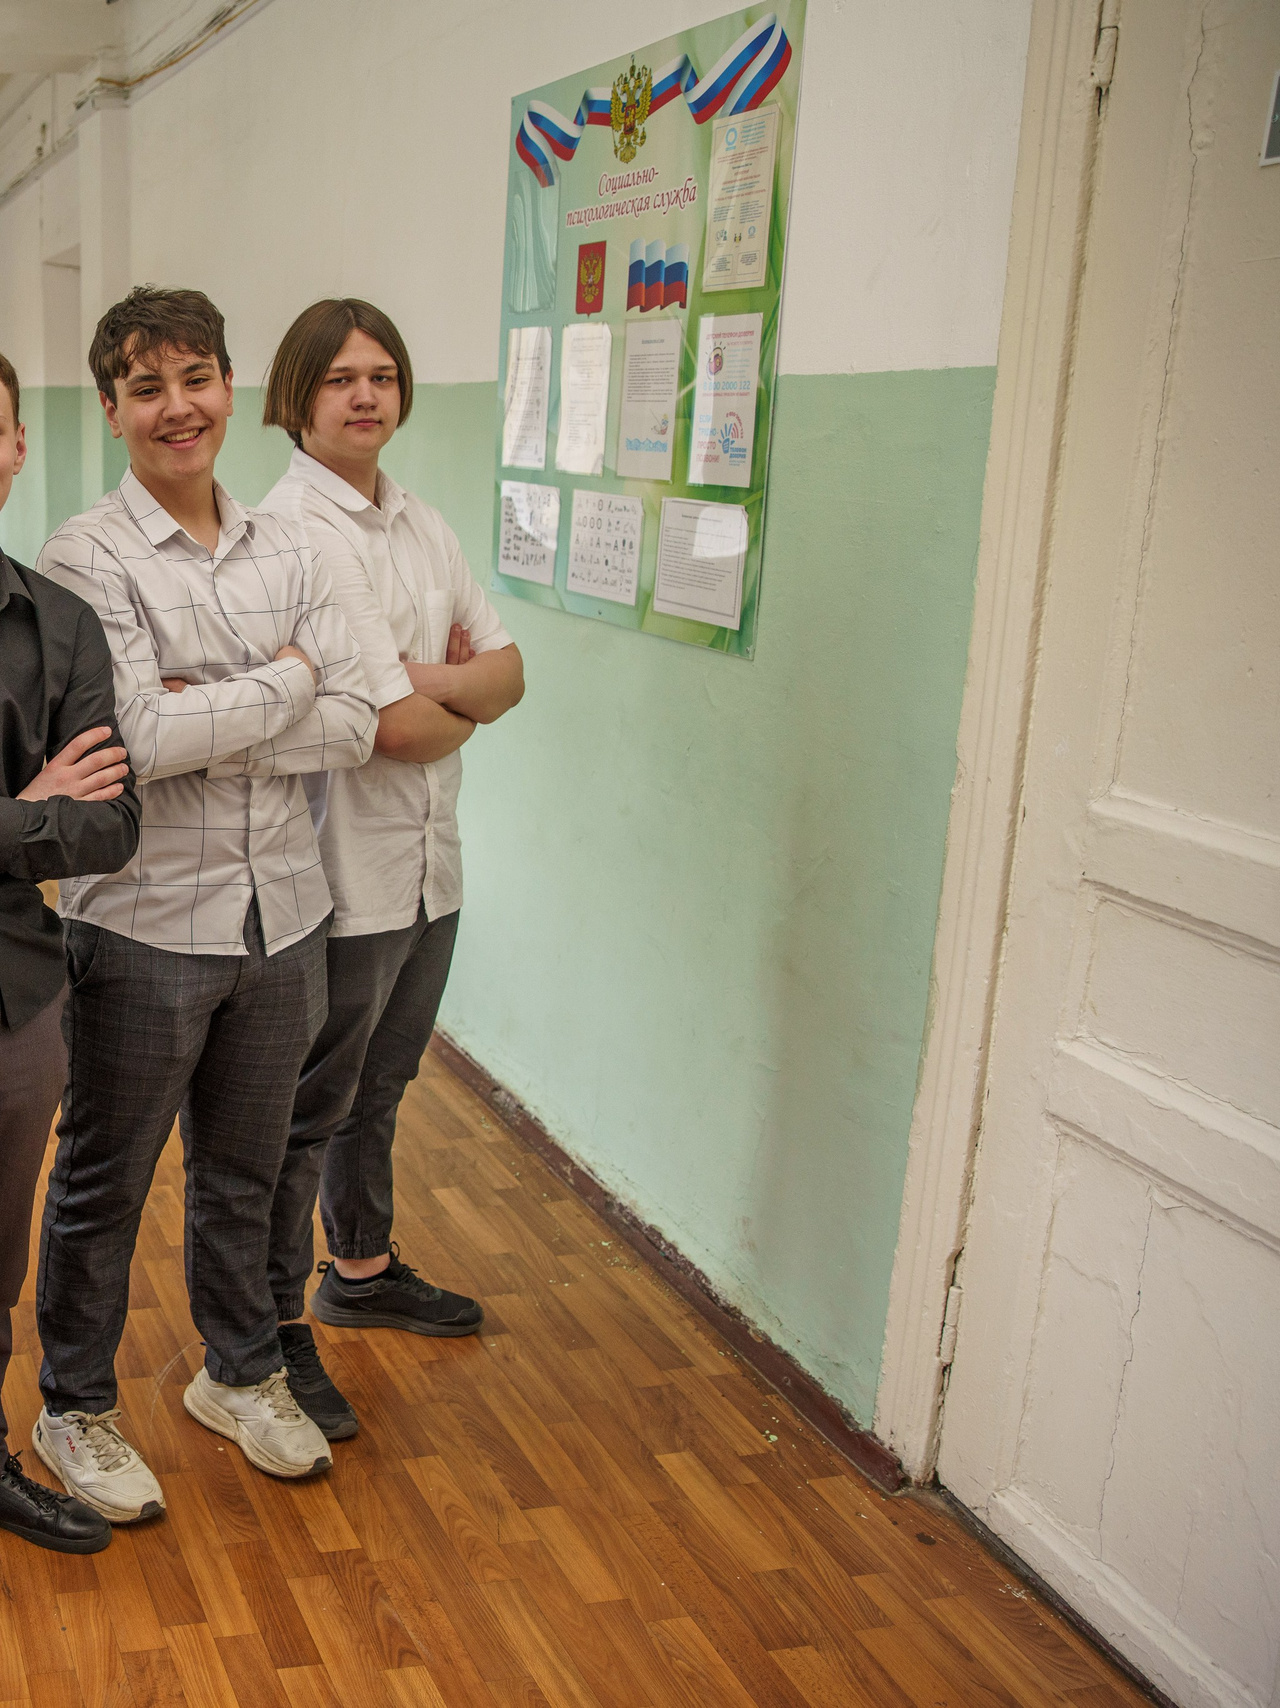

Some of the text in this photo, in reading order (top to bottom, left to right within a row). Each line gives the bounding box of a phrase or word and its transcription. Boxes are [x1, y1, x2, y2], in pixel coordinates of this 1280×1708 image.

[598, 167, 659, 197] Социально-
[566, 195, 651, 227] психологическая
[653, 177, 697, 215] служба
[721, 381, 738, 390] 2000
[739, 380, 751, 390] 122
[66, 1435, 76, 1453] FILA
